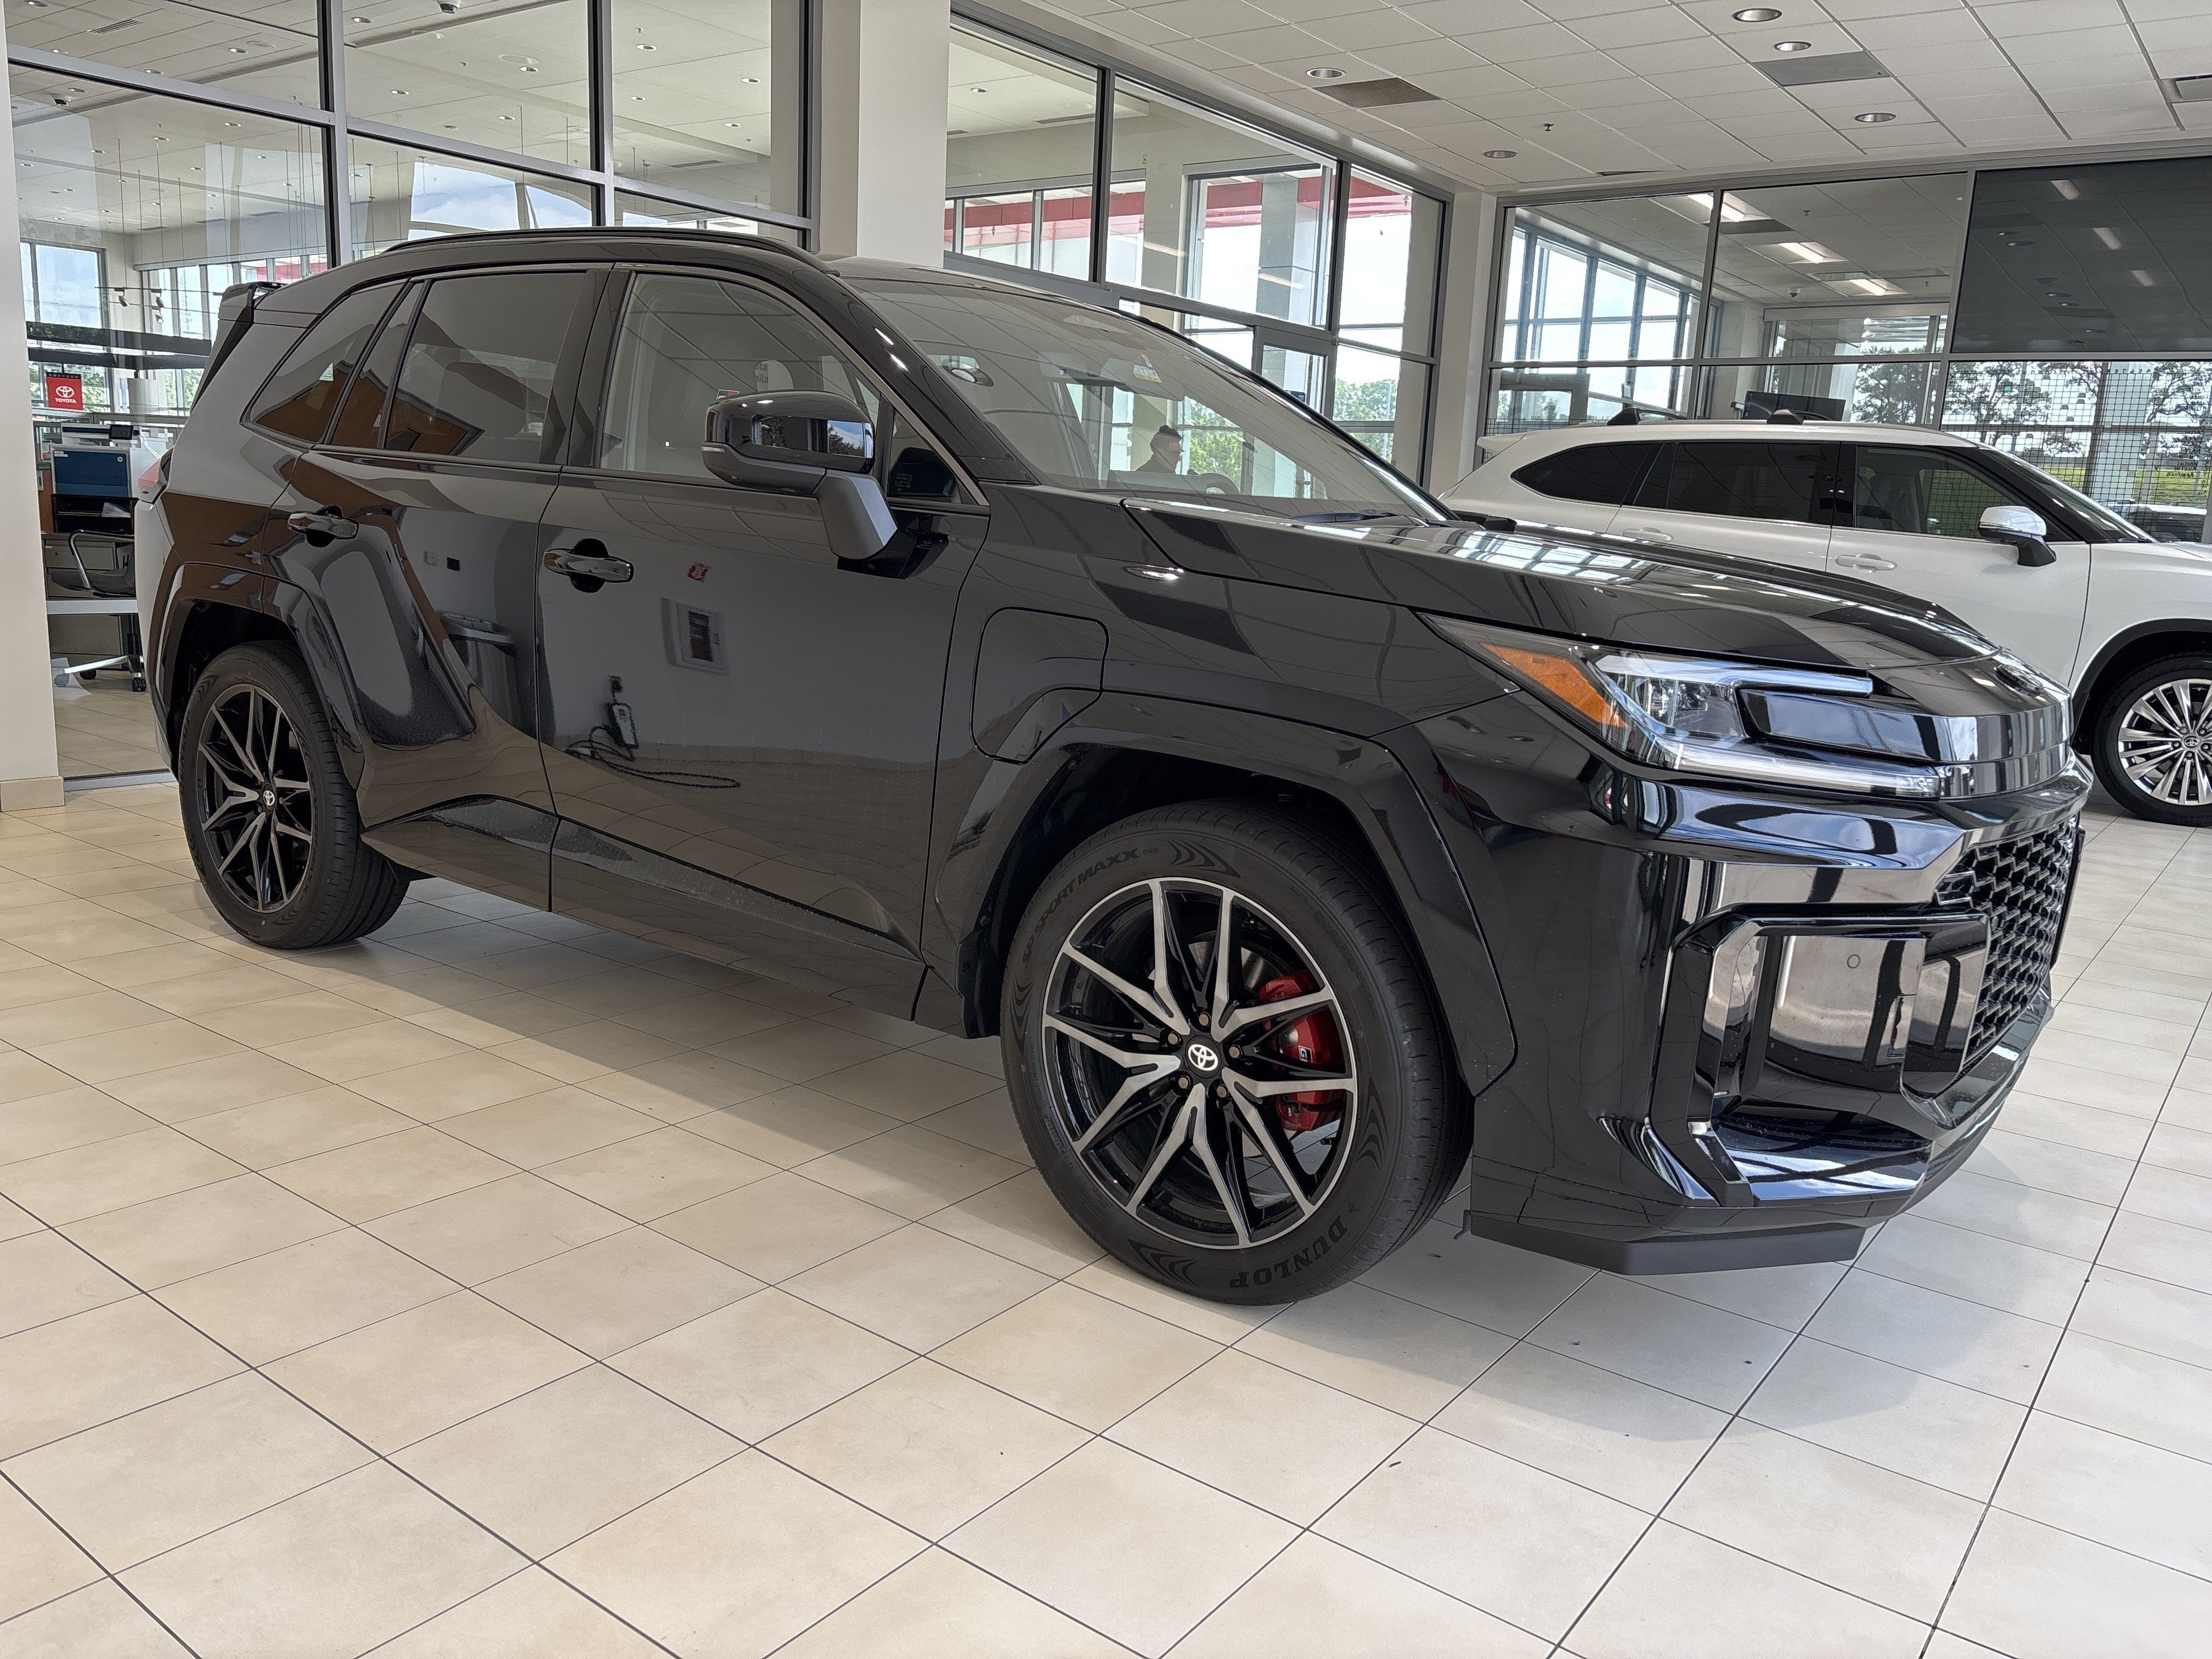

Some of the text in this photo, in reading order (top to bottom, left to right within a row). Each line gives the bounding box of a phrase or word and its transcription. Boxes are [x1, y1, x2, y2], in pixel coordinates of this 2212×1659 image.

[1034, 876, 1076, 939] SPORT
[1077, 847, 1141, 885] MAXX
[1228, 1214, 1348, 1289] DUNLOP
